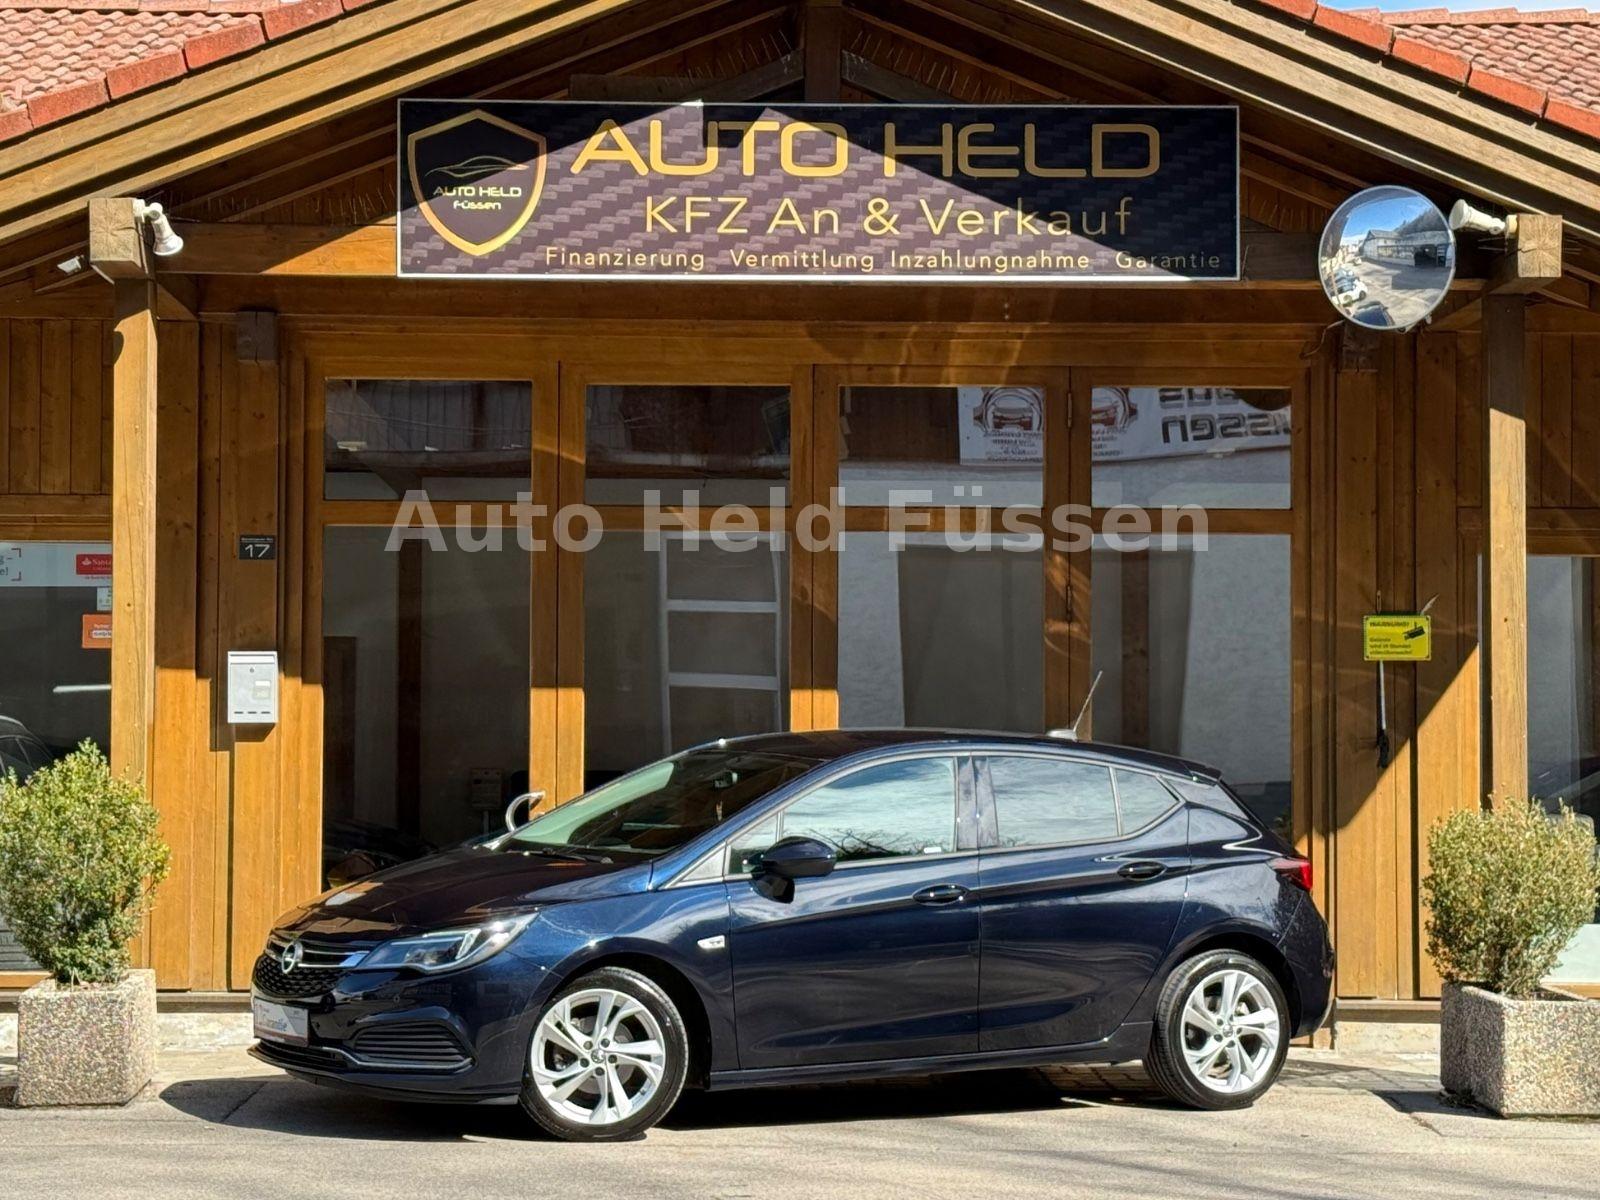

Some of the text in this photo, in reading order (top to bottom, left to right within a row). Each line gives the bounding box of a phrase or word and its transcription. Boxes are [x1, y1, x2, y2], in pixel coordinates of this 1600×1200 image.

[570, 119, 1161, 178] AUTO HELD
[433, 186, 522, 197] AUTO HELD
[646, 196, 1133, 236] KFZ An & Verkauf
[545, 247, 1221, 273] Finanzierung Vermittlung Inzahlungnahme Garantie
[245, 544, 270, 558] 17
